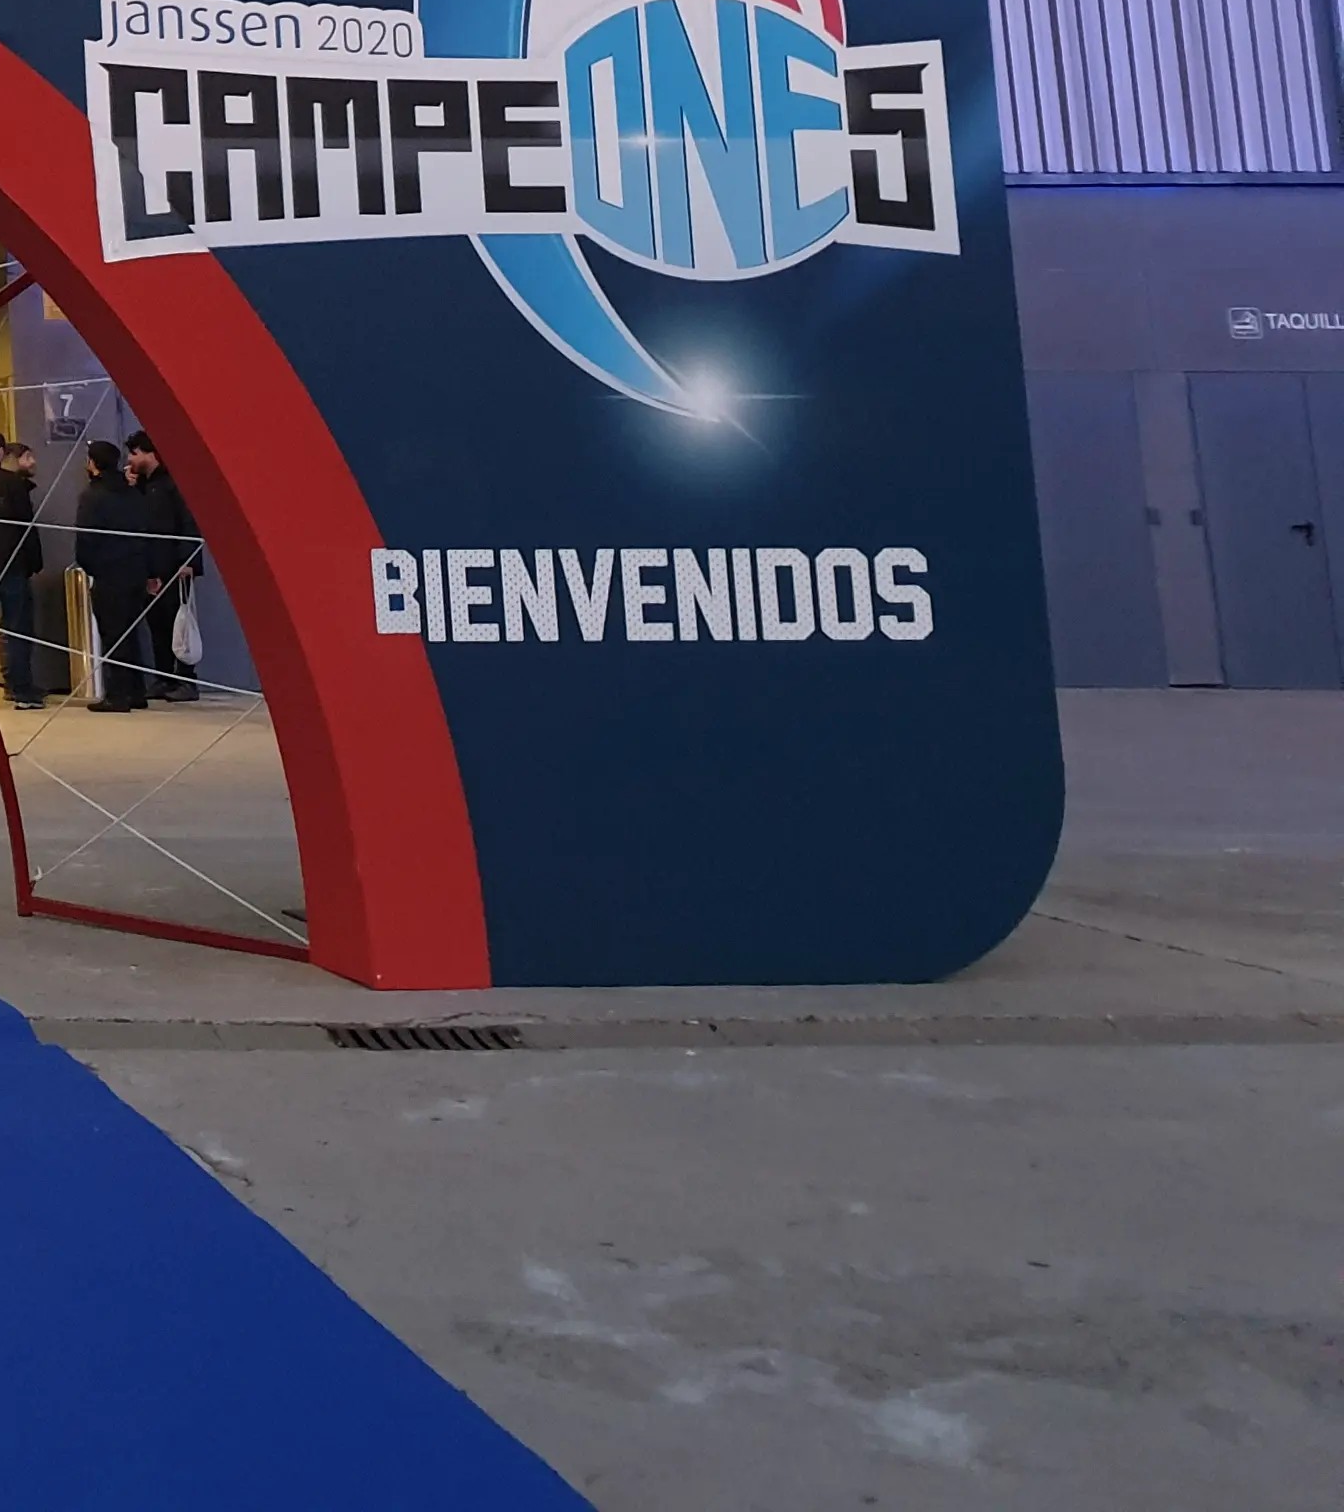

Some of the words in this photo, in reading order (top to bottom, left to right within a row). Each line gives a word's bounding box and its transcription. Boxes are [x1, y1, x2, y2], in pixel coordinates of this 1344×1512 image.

[316, 13, 415, 58] 2020
[59, 394, 74, 417] 7
[370, 547, 934, 643] BIENVENIDOS
